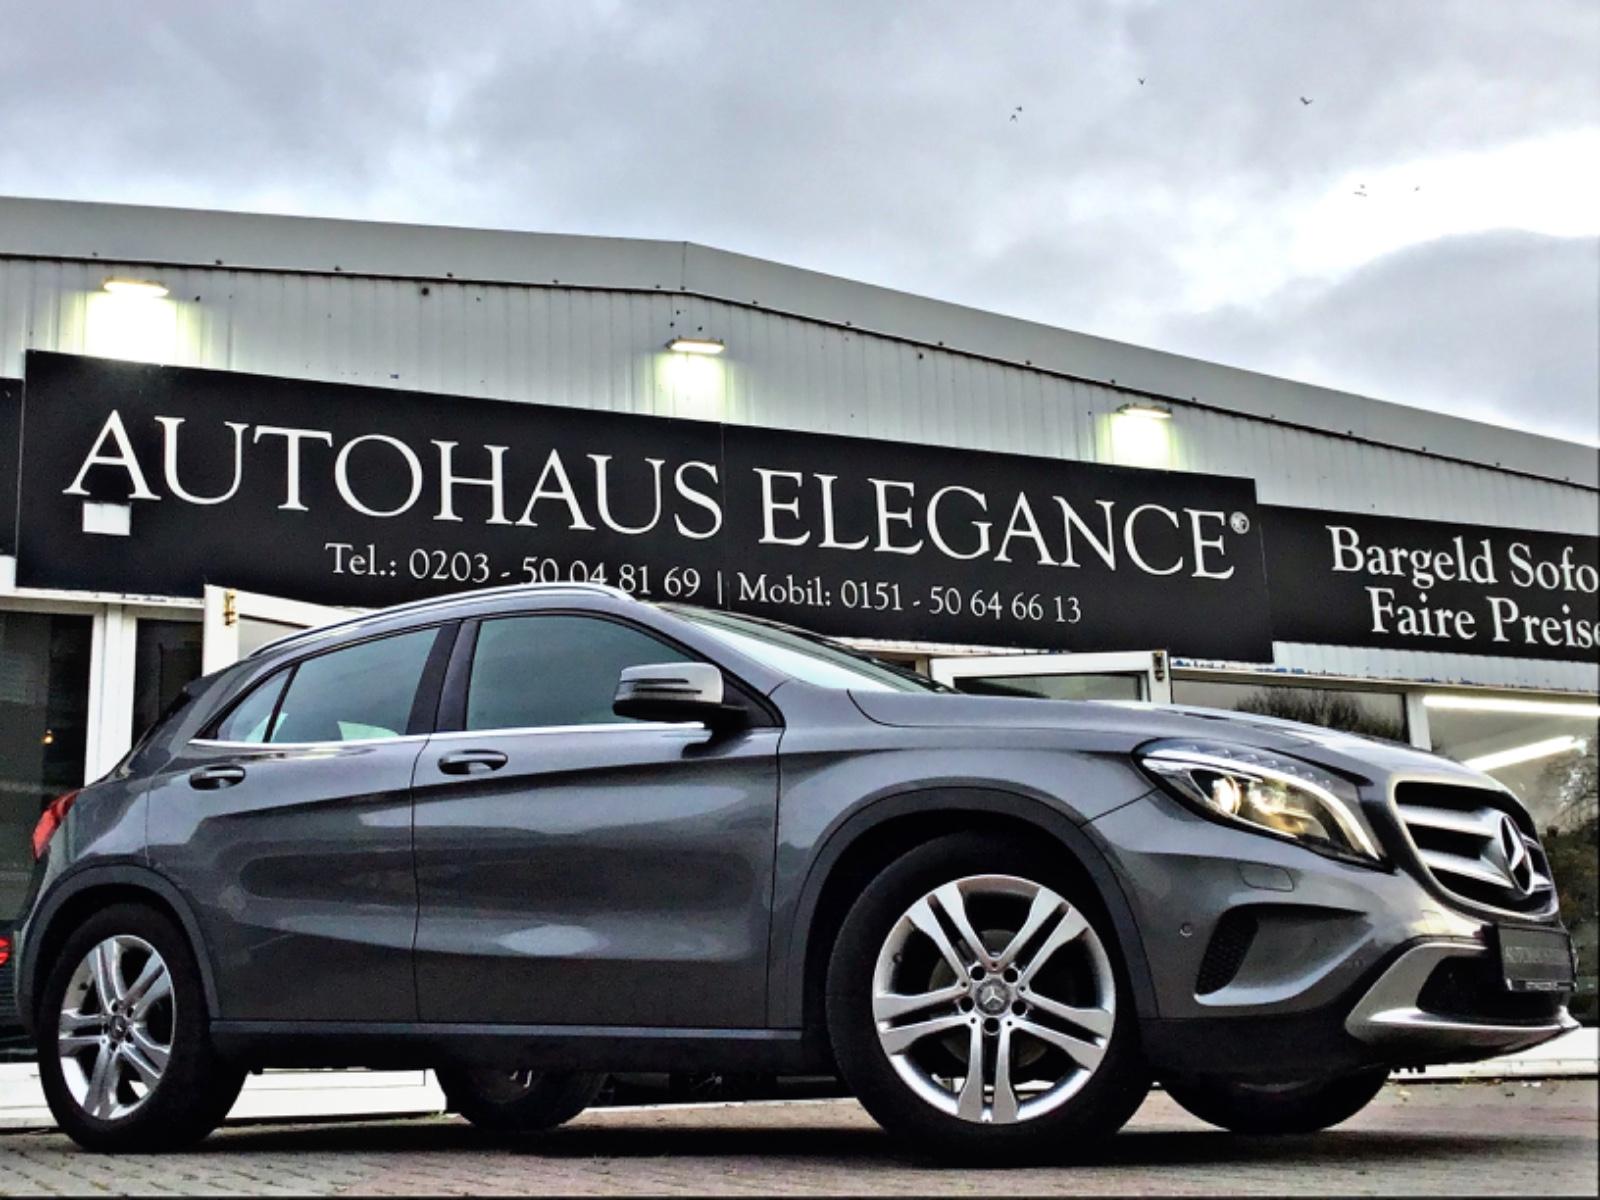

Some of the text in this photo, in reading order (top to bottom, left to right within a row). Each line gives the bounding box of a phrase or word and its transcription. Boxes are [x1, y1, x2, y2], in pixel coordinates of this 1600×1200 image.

[63, 408, 724, 540] AUTOHAUS
[325, 543, 396, 576] Tel.:
[410, 549, 489, 582] 0203
[523, 557, 560, 583] 50
[564, 561, 607, 583] 04
[618, 563, 651, 596] 81
[665, 567, 700, 596] 69
[737, 573, 830, 606] Mobil:
[841, 580, 902, 610] 0151
[930, 587, 961, 614] 50
[971, 590, 1002, 619] 64
[1012, 593, 1043, 620] 66
[1055, 596, 1080, 622] 13
[1325, 525, 1499, 589] Bargeld
[1364, 586, 1477, 640] Faire
